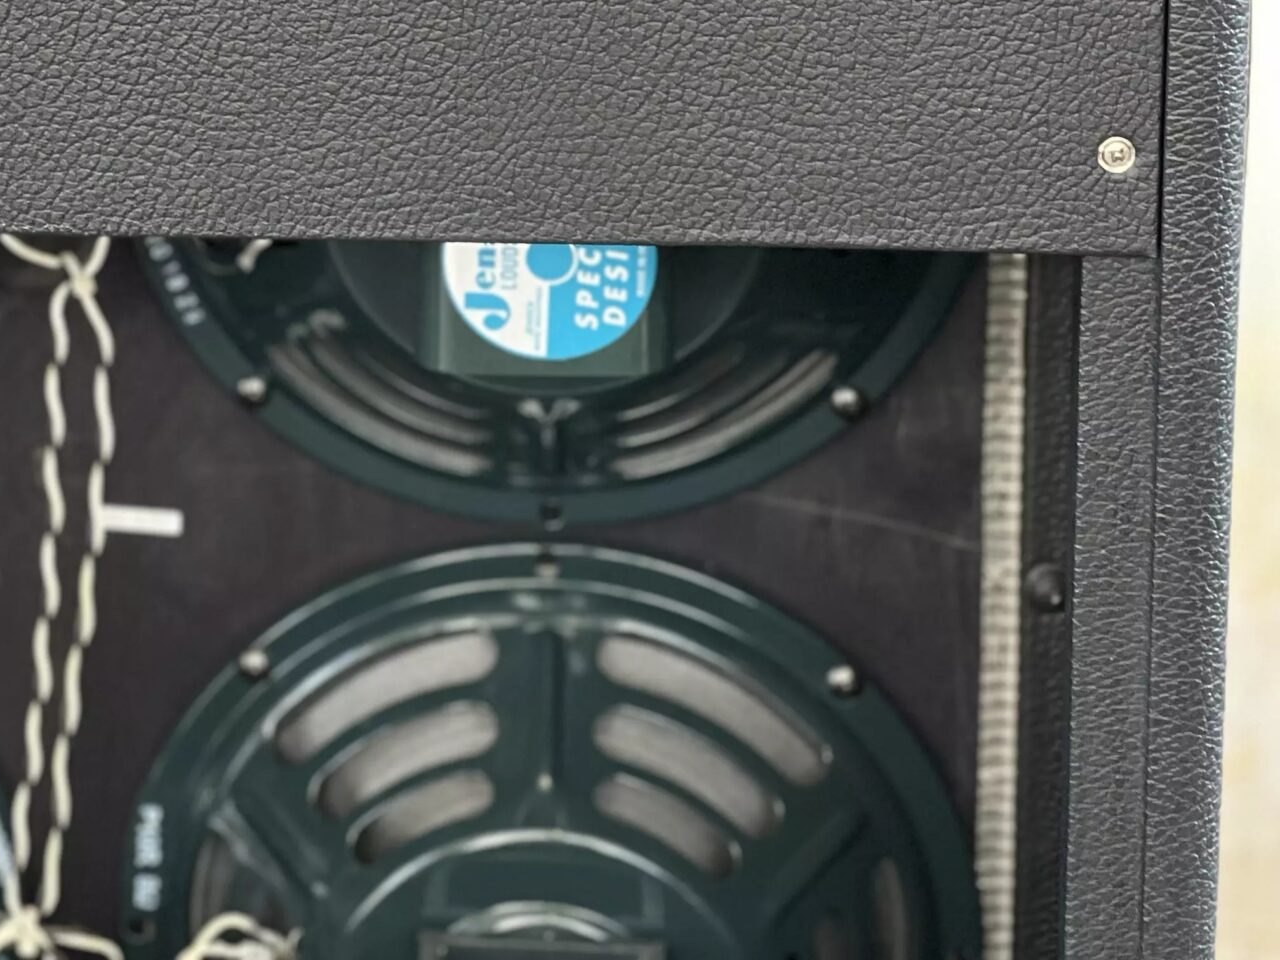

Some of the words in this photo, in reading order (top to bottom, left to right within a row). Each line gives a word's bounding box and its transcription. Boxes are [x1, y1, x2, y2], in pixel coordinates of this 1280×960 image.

[464, 244, 511, 331] Jen
[500, 246, 519, 290] LOUD
[574, 246, 603, 331] SPEC
[602, 249, 629, 328] DESI
